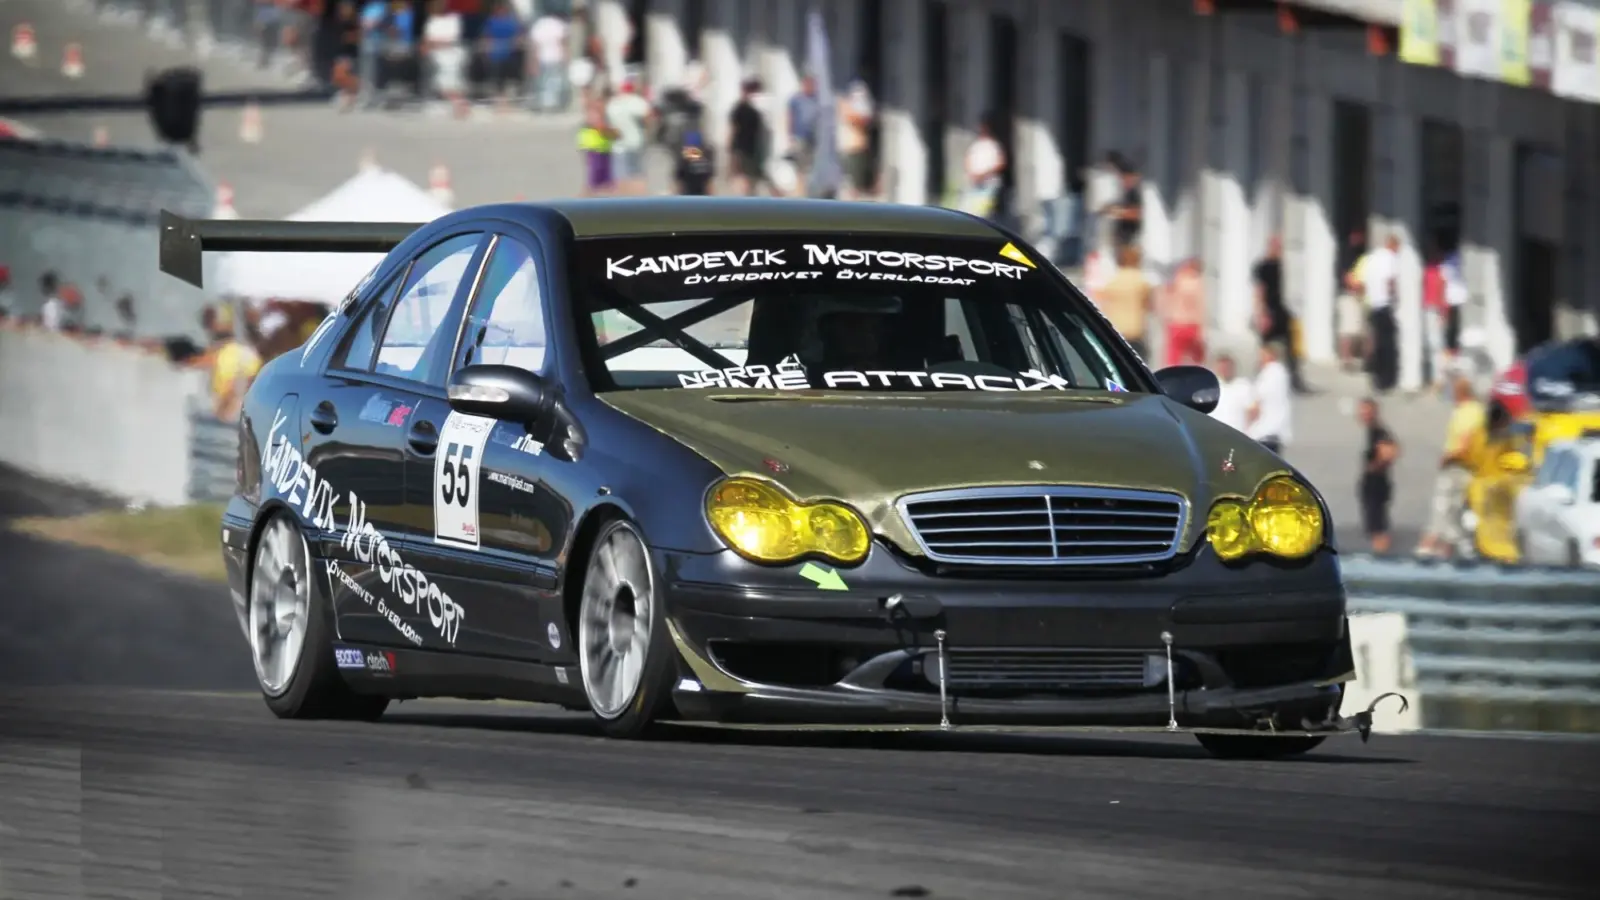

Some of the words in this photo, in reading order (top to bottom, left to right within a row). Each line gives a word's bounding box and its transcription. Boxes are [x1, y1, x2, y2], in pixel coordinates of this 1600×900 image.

[606, 249, 787, 279] KANDEVIK
[803, 244, 1029, 280] MOTORSPORT
[836, 269, 976, 286] ÖVERLADDAT
[441, 442, 475, 508] 55
[261, 407, 340, 534] KANDEVIK
[340, 490, 465, 648] MOTORSPORT
